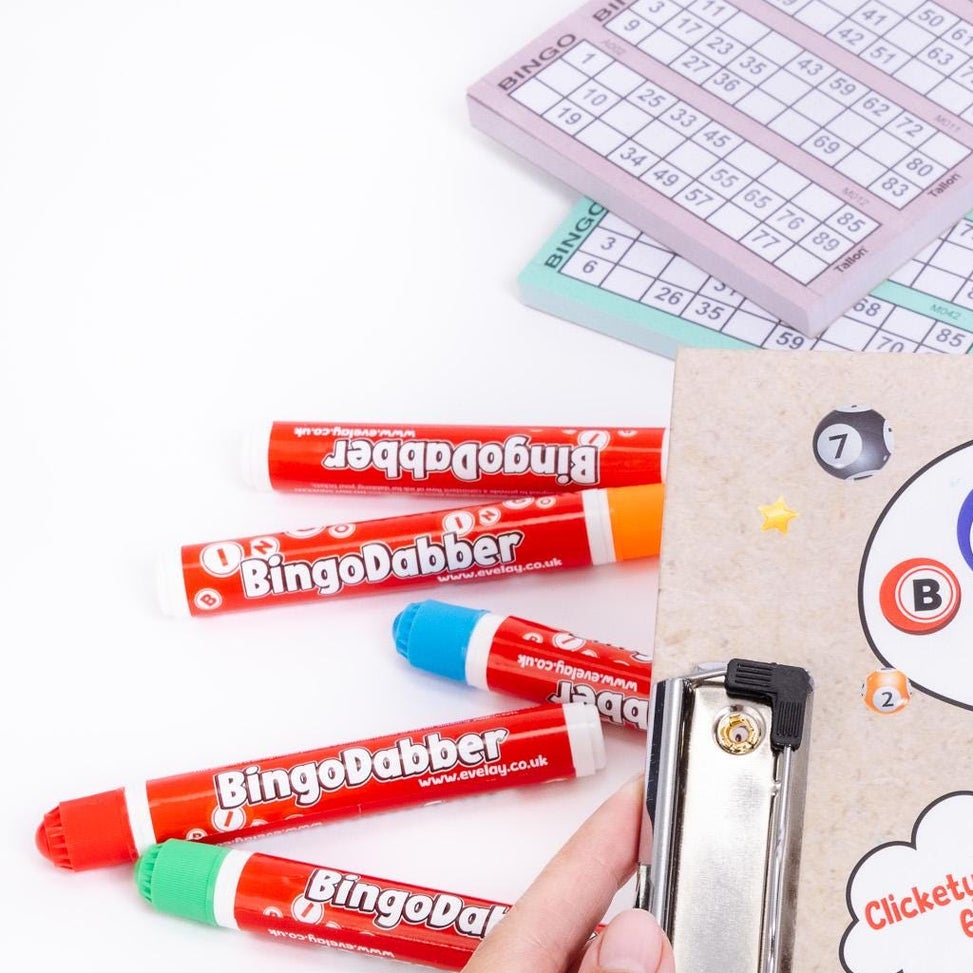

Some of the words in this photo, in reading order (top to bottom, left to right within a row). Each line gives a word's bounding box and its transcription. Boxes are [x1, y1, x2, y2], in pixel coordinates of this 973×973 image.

[496, 32, 577, 93] BINGO
[797, 58, 824, 76] 43
[828, 76, 857, 96] 59
[862, 97, 891, 117] 62
[896, 116, 924, 138] 72
[557, 107, 583, 126] 19
[619, 146, 648, 167] 34
[652, 169, 680, 187] 49
[684, 188, 715, 206] 57
[751, 228, 782, 249] 77
[583, 88, 608, 106] 10
[710, 168, 740, 188] 55
[742, 188, 773, 209] 65
[776, 208, 806, 230] 76
[812, 231, 841, 252] 89
[636, 88, 667, 108] 25
[669, 108, 698, 128] 33
[702, 130, 732, 148] 45
[836, 212, 866, 233] 85
[813, 135, 841, 154] 69
[881, 176, 910, 198] 83
[905, 157, 934, 178] 80
[927, 172, 962, 198] Tallon
[833, 246, 869, 273] Tallon
[653, 286, 684, 306] 26
[694, 301, 726, 321] 35
[935, 328, 966, 348] 85
[322, 438, 600, 484] BingoDabber
[828, 432, 849, 460] 7
[240, 530, 524, 599] BingoDabber
[437, 557, 563, 582] www.evelay.co.uk
[517, 654, 638, 692] www.evelay.co.uk
[881, 691, 895, 708] 2
[214, 728, 509, 808] BingoDabber
[418, 755, 548, 788] www.evelay.co.uk
